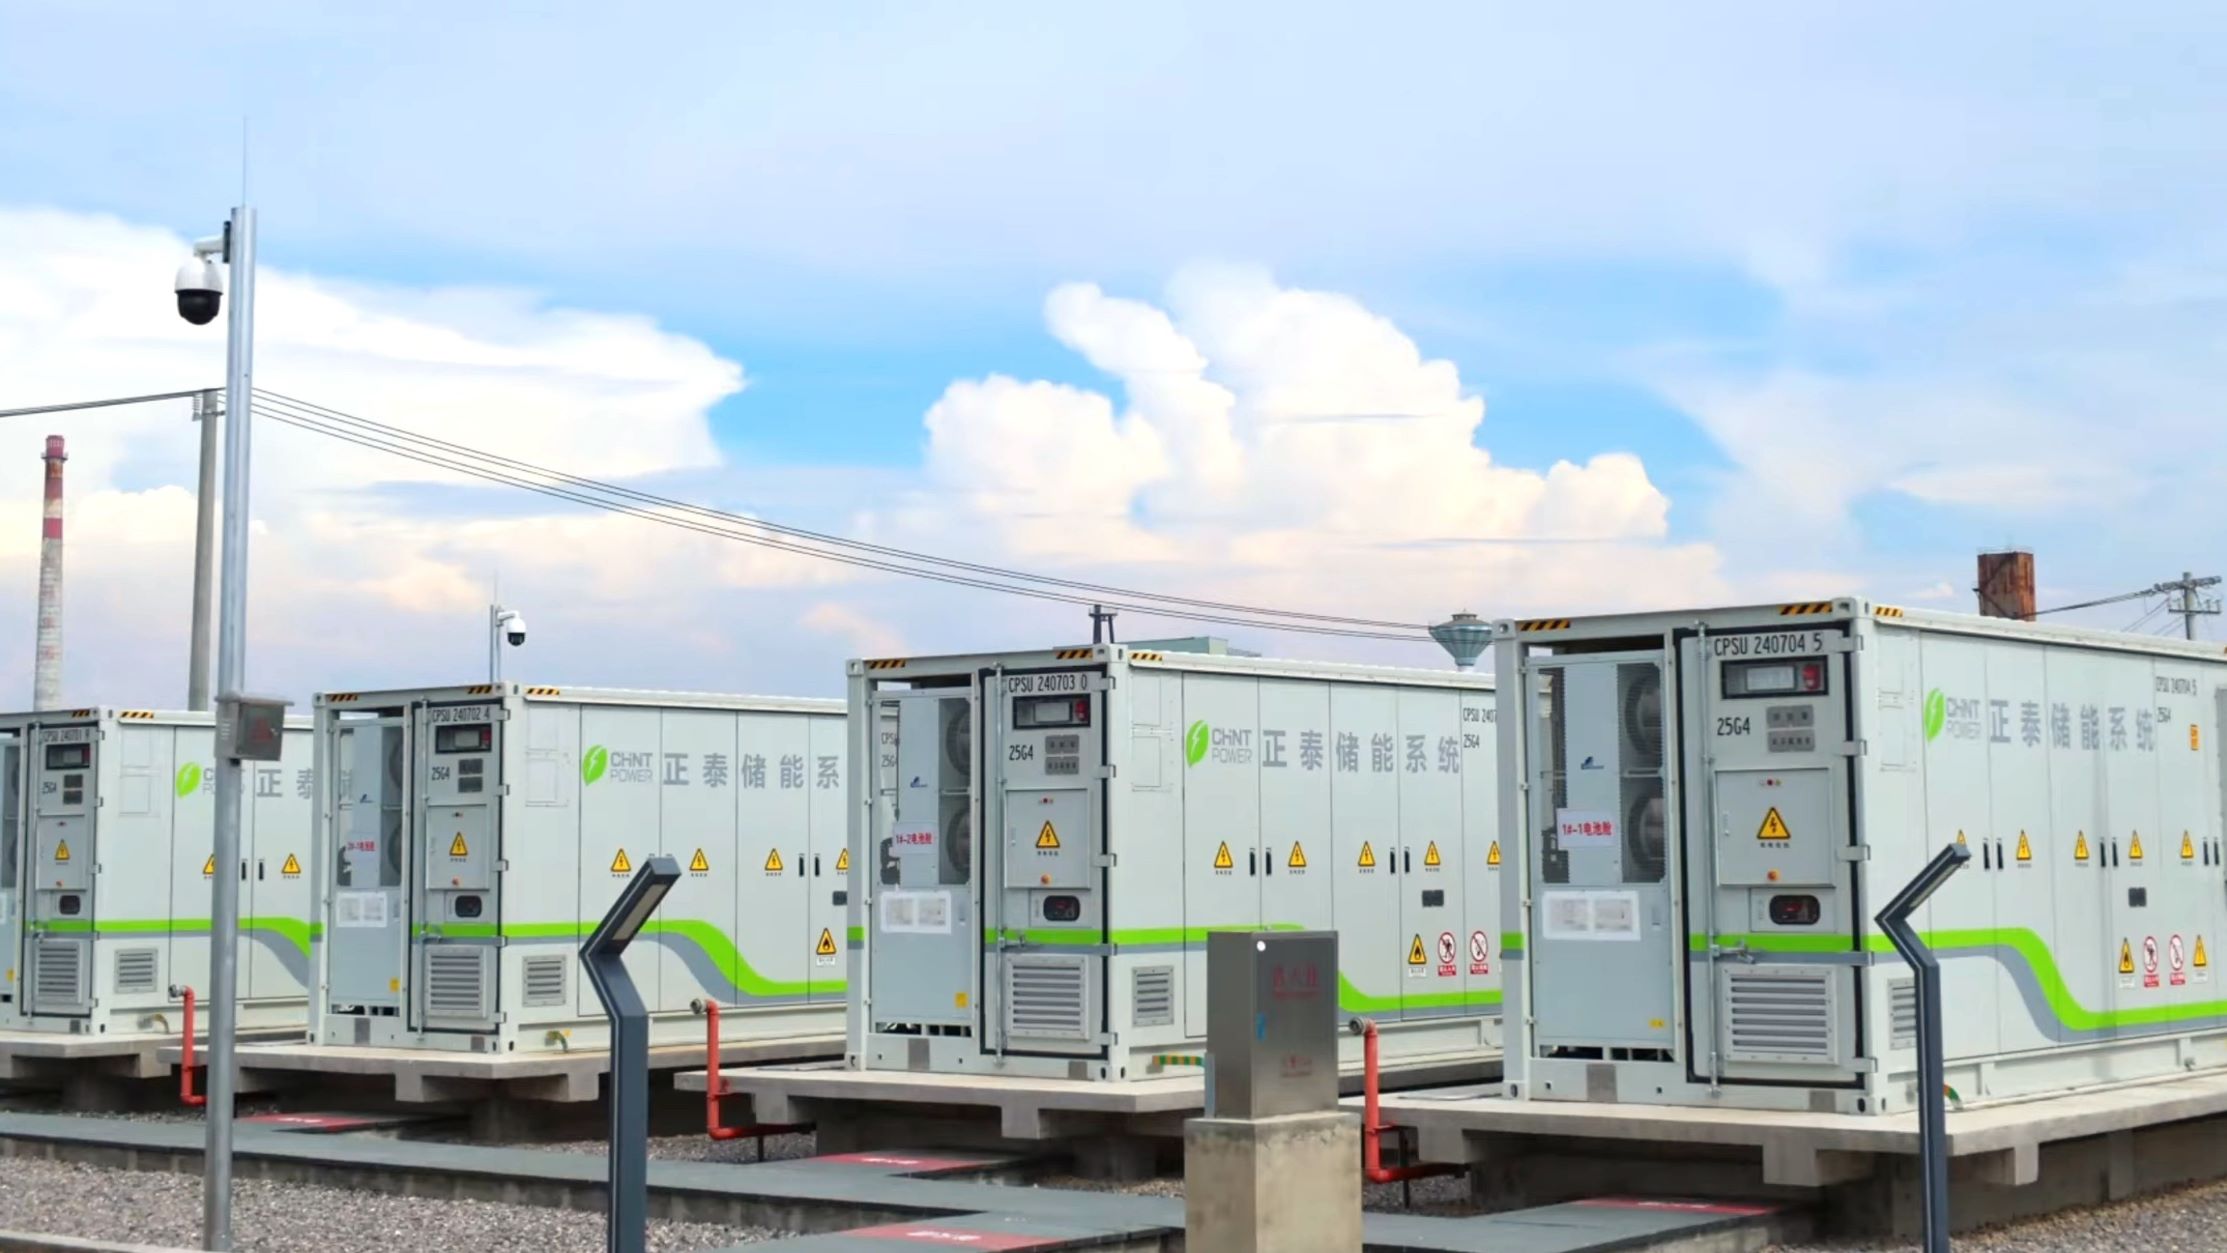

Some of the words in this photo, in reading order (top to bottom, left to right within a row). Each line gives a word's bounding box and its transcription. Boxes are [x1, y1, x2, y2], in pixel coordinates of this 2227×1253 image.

[1714, 637, 1748, 656] CPSU
[1754, 634, 1805, 654] 240704
[1813, 632, 1823, 652] 5
[1009, 677, 1033, 693] CPSU
[1037, 674, 1075, 692] 240703
[432, 708, 450, 723] CPSU
[1463, 707, 1480, 723] CPSU
[1717, 717, 1750, 736] 25G4
[1989, 699, 2154, 752] 正泰储能系统
[1463, 734, 1480, 749] 25G4
[1009, 744, 1034, 761] 25G4
[1212, 747, 1253, 764] POWER
[1262, 730, 1460, 773] 正泰储能系统
[610, 769, 653, 783] POWER
[663, 753, 840, 789] 正泰储能系
